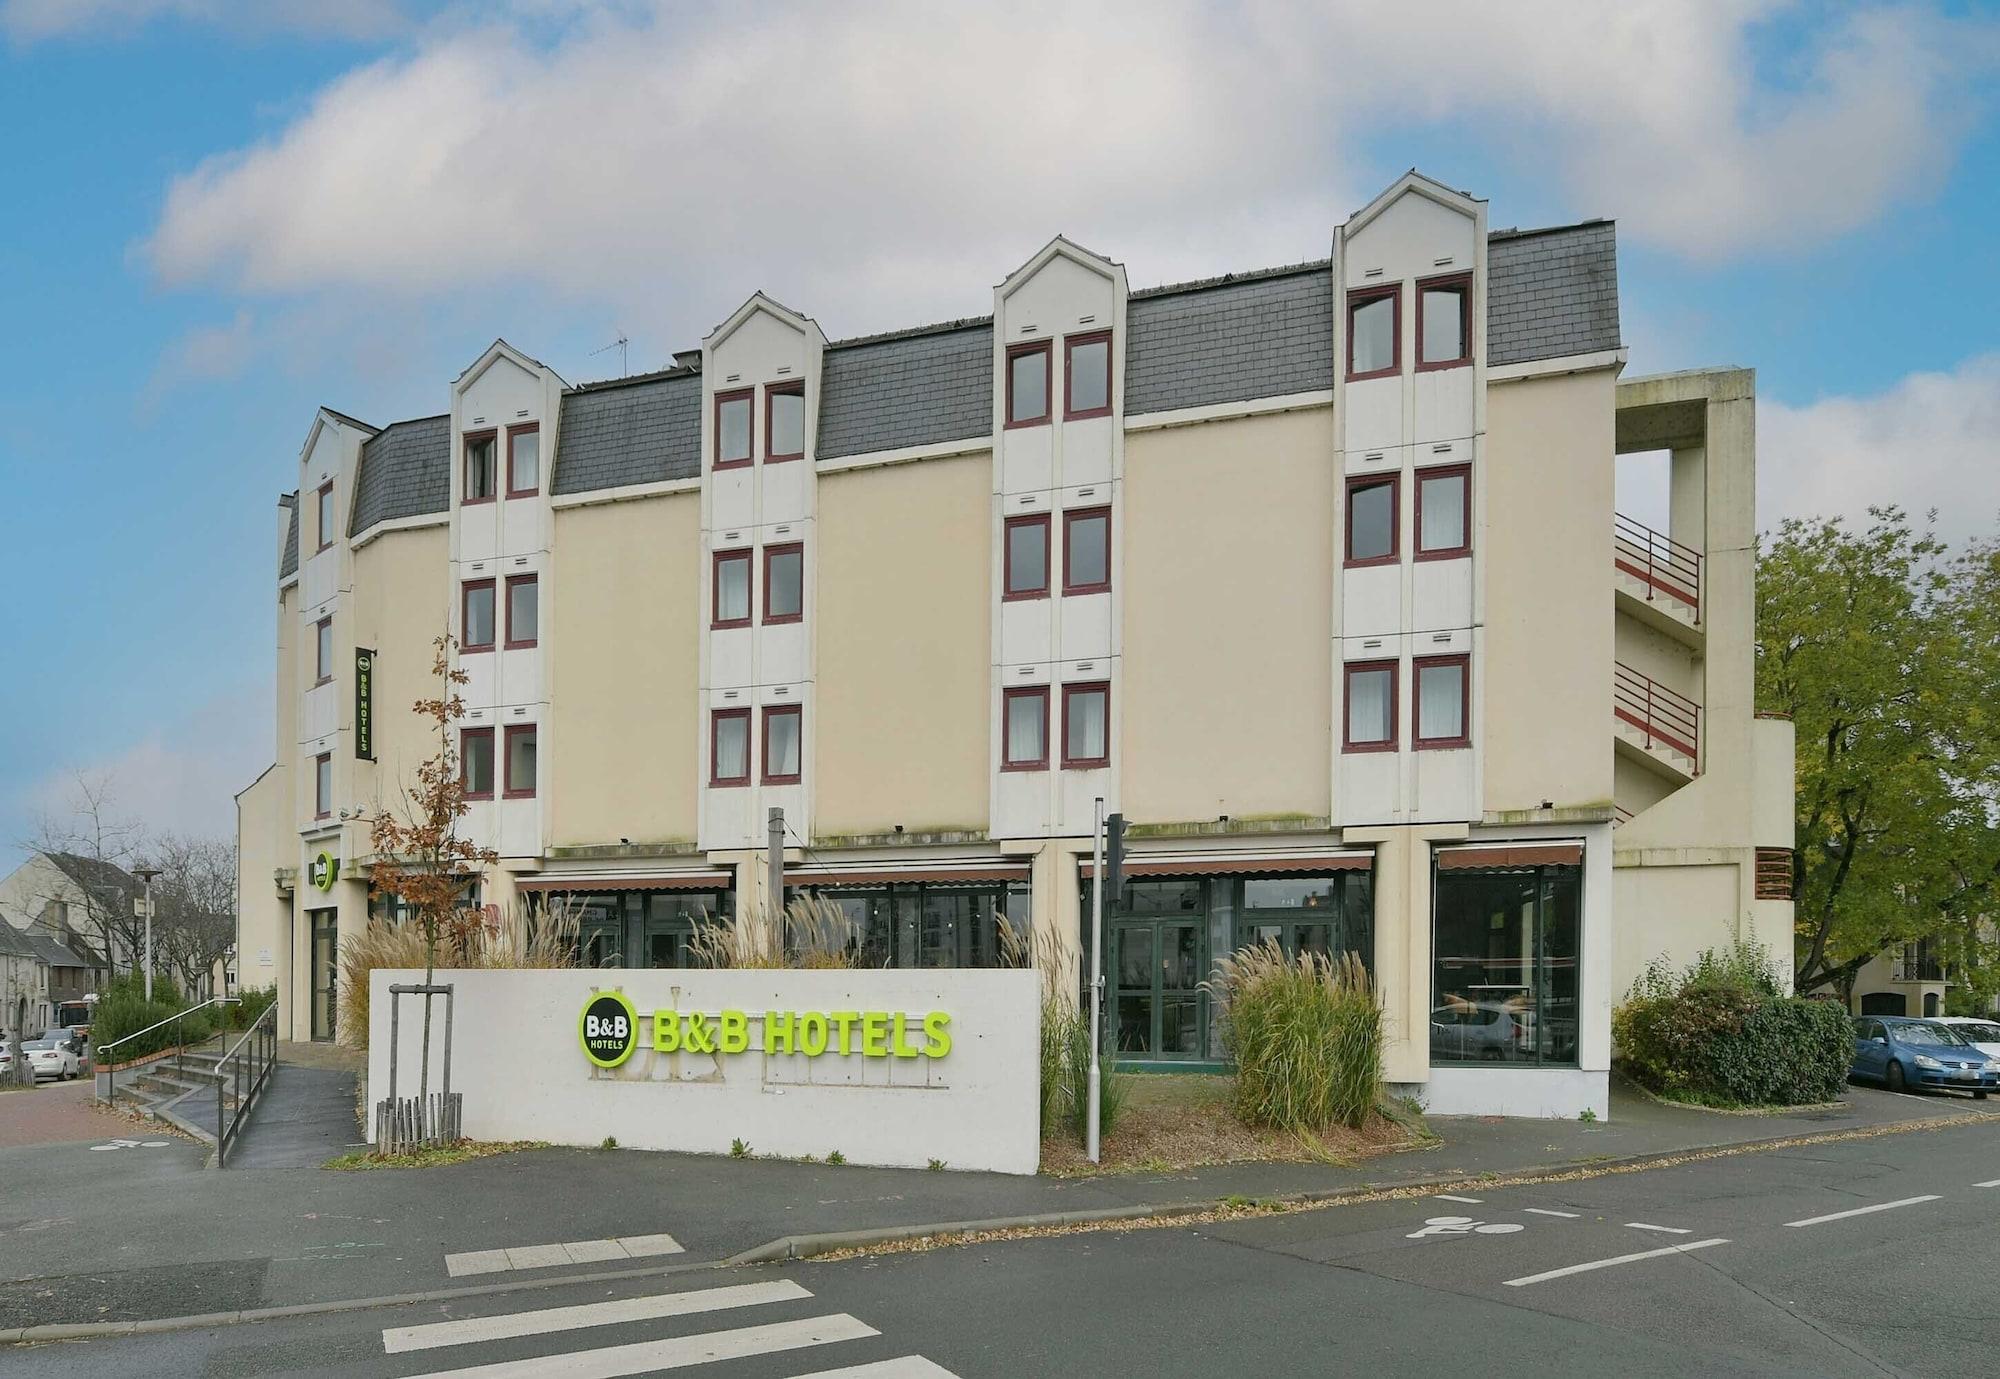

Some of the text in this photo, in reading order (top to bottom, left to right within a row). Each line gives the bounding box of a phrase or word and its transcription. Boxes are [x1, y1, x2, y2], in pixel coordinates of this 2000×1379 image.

[360, 674, 368, 697] B&B
[360, 700, 368, 752] HOTELS
[586, 1015, 628, 1038] B&B
[653, 1009, 953, 1058] B&B HOTELS
[590, 1040, 624, 1050] HOTELS
